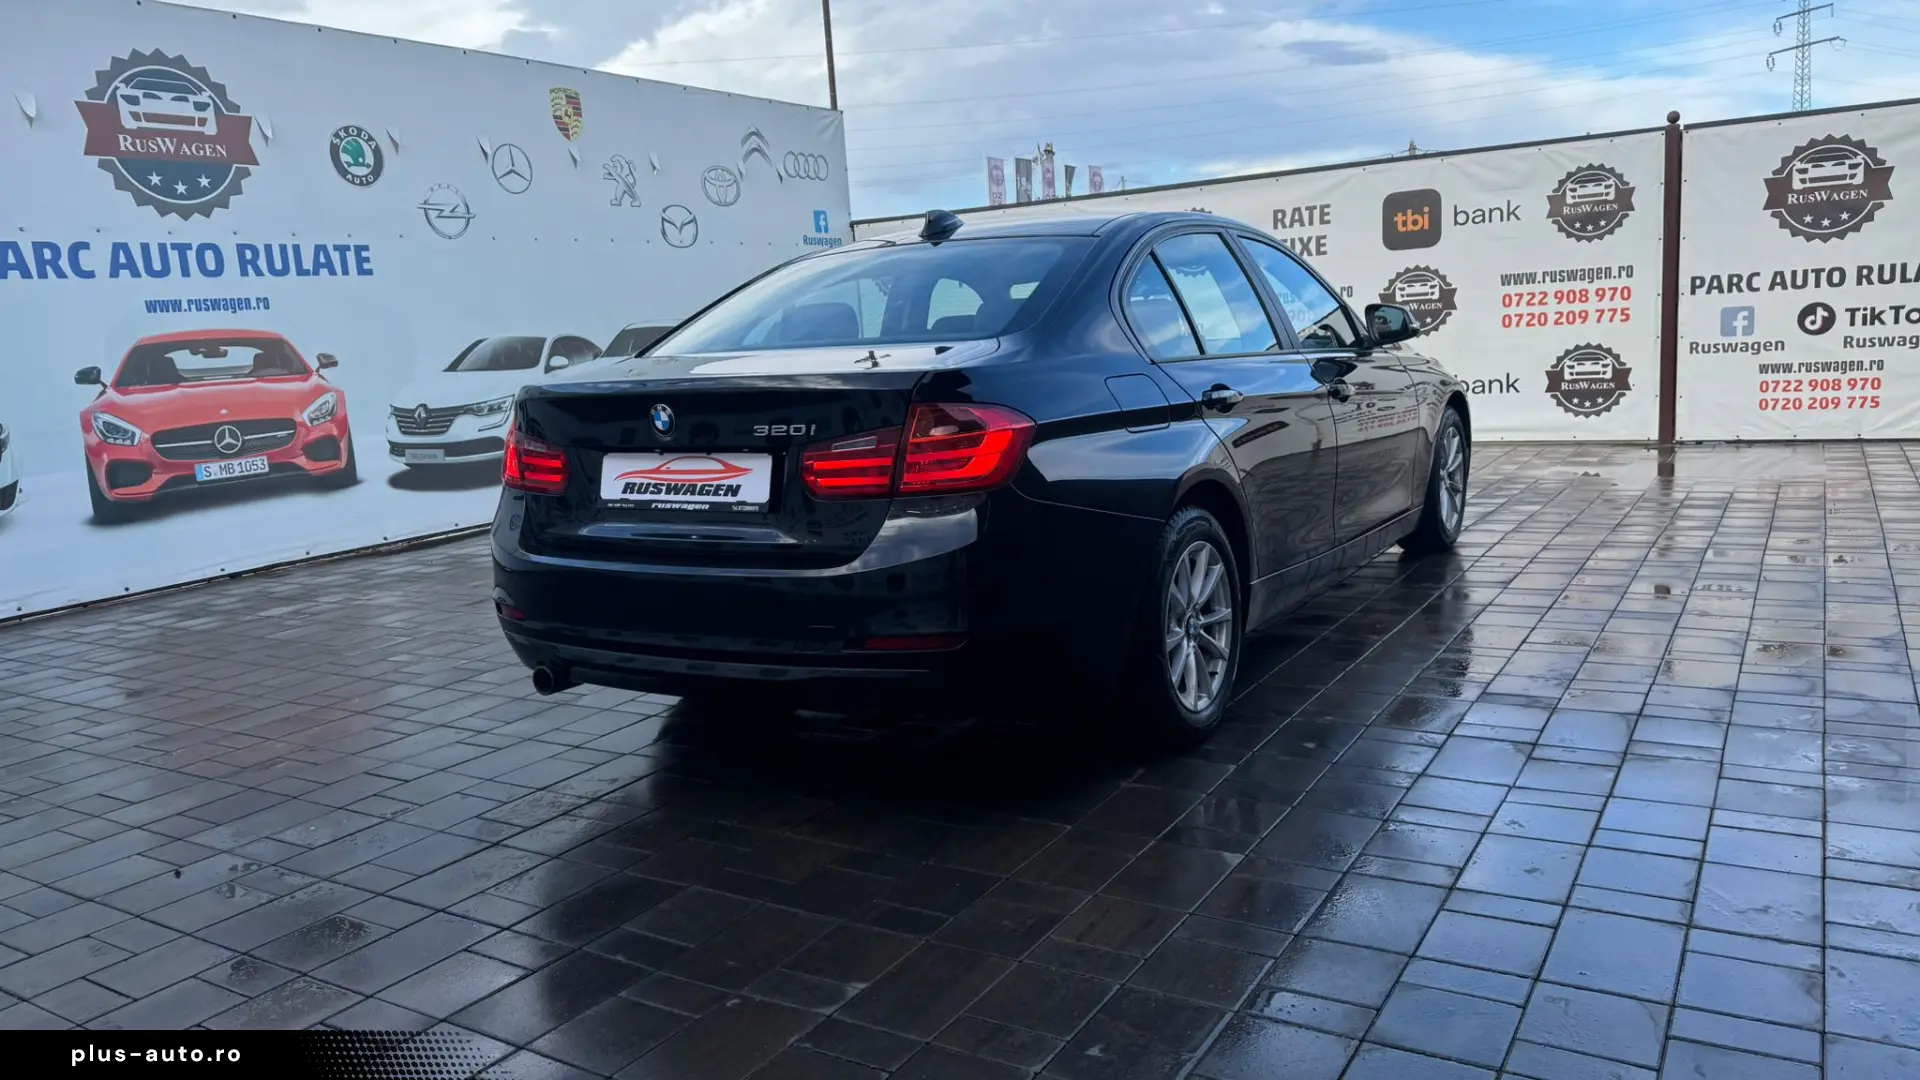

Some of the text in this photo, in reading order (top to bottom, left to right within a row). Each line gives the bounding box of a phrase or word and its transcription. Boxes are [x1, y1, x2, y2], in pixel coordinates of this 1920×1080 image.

[345, 174, 374, 185] AUTO
[1273, 203, 1332, 230] RATE
[1394, 199, 1522, 232] tbi bank
[803, 234, 843, 248] Ruswagen
[109, 242, 225, 278] AUTO
[236, 243, 374, 278] RULATE
[1500, 264, 1634, 287] www.ruswagen.ro
[1690, 272, 1761, 296] PARC
[1768, 266, 1847, 291] AUTO
[144, 296, 270, 314] www.ruswagen.ro
[1502, 286, 1632, 308] 0722 908 970
[1502, 307, 1631, 328] 0720 209 775
[1689, 340, 1785, 355] Ruswagen
[1843, 335, 1920, 350] Ruswag
[1758, 359, 1884, 374] www.ruswagen.ro
[1760, 377, 1881, 393] 0722 908 970
[1758, 395, 1880, 411] 0720 209 775
[204, 458, 267, 478] S MB 1053
[621, 481, 743, 498] RUSWAGEN
[651, 502, 710, 511] ruswagen
